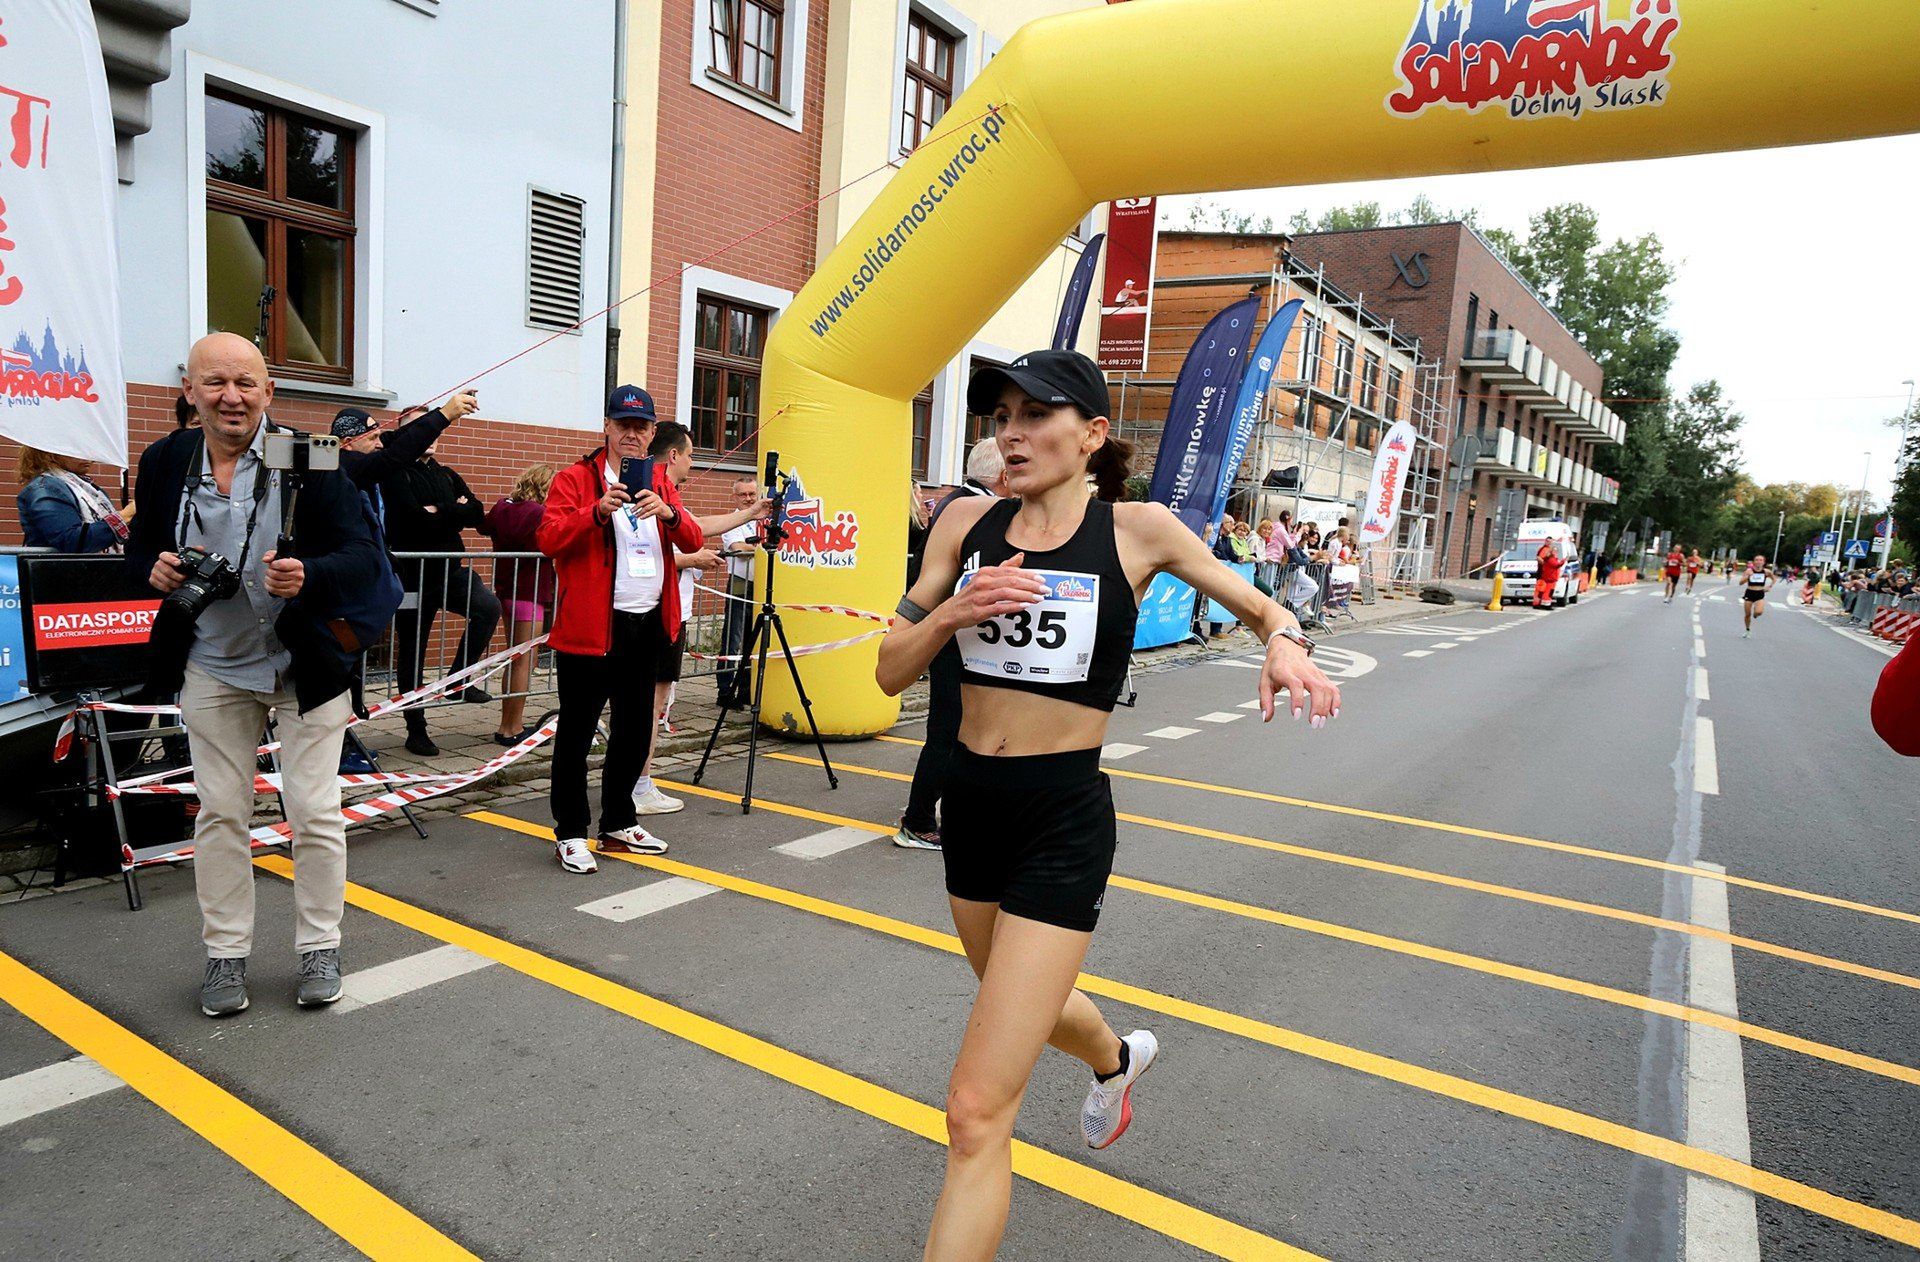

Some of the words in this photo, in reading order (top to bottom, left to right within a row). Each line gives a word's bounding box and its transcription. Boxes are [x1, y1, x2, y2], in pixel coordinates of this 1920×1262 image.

[1510, 91, 1581, 117] Dolny
[809, 103, 1006, 338] www.solidarnosc.wroc.pl
[1168, 386, 1217, 513] PijKranówkę
[781, 550, 814, 568] Dolny
[45, 629, 105, 639] ELEKTRONICZNY
[977, 609, 1066, 650] 535
